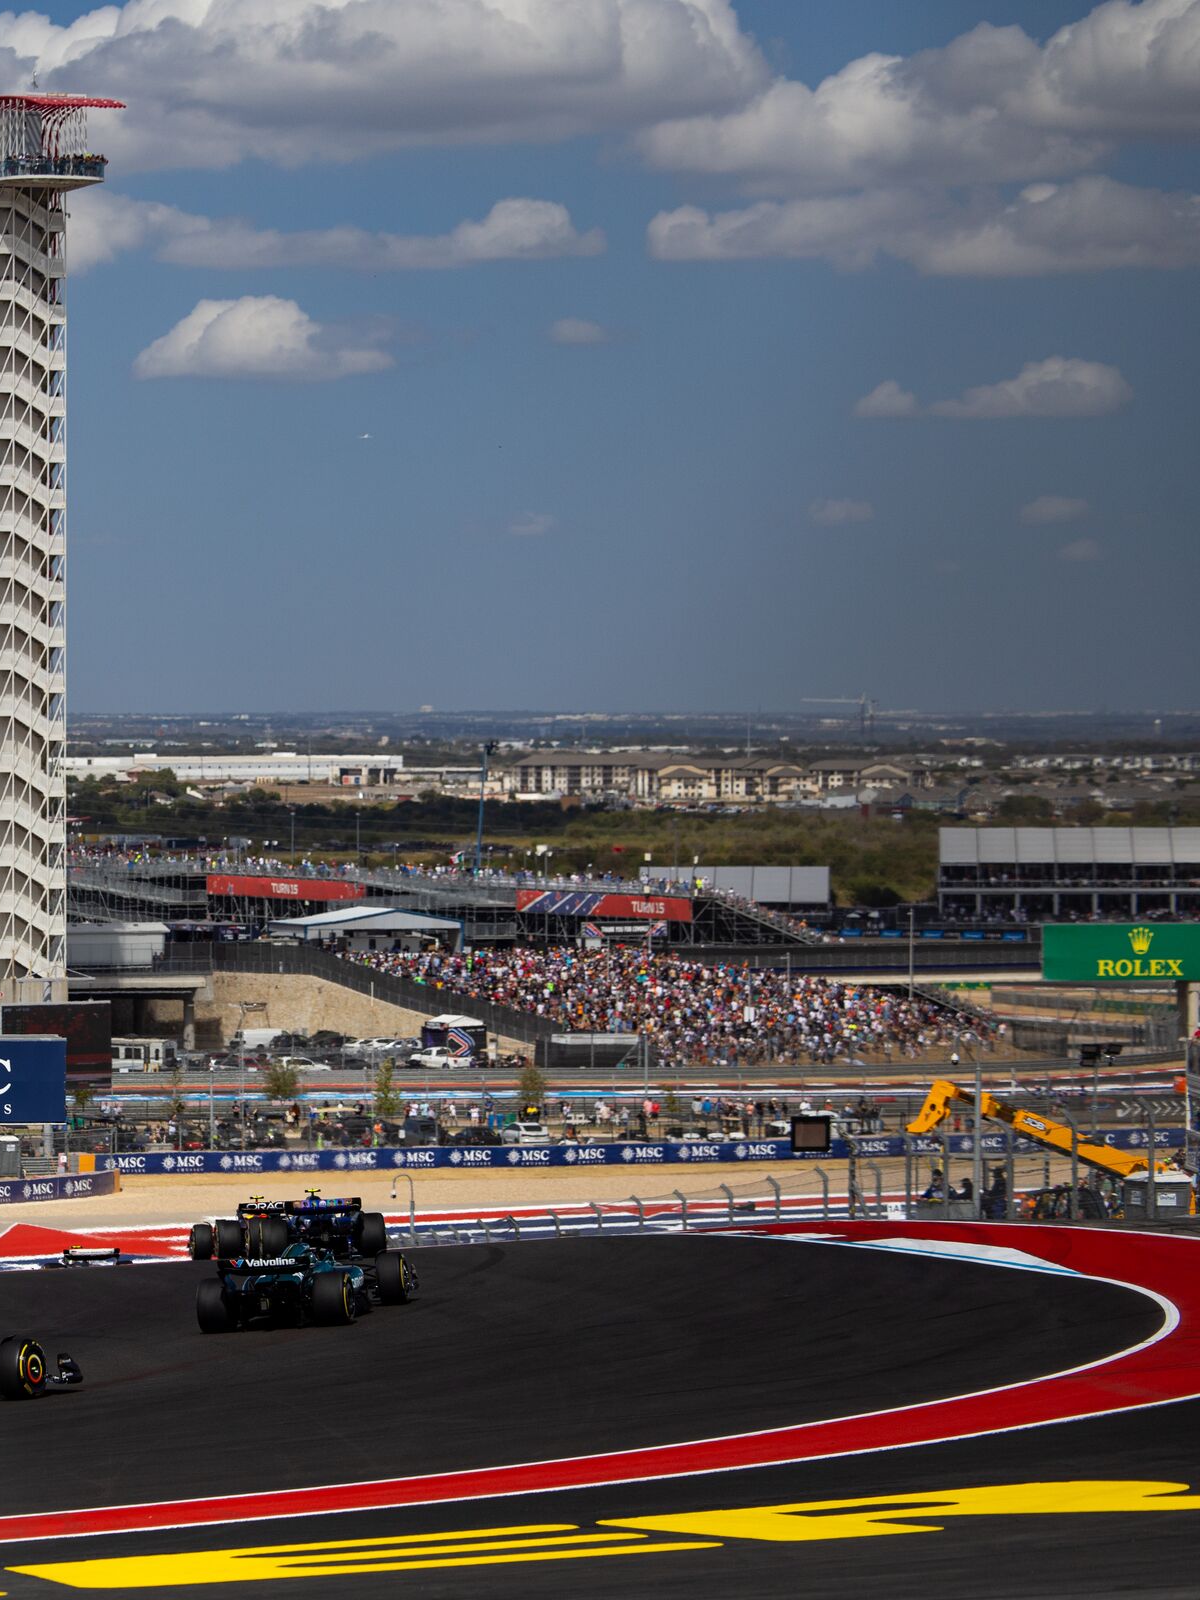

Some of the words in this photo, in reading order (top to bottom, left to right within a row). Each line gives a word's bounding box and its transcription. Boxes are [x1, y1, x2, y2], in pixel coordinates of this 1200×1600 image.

[632, 901, 655, 914] TURN
[655, 902, 665, 914] 15
[1097, 959, 1184, 977] ROLEX
[522, 1150, 549, 1160] MSC
[578, 1149, 605, 1159] MSC
[635, 1148, 662, 1158] MSC
[692, 1145, 720, 1156] MSC
[748, 1144, 776, 1155] MSC
[234, 1155, 262, 1166] MSC
[406, 1152, 434, 1162] MSC
[463, 1150, 491, 1161] MSC
[118, 1157, 145, 1168] MSC
[176, 1156, 204, 1167] MSC
[32, 1183, 53, 1194] MSC
[73, 1180, 92, 1191] MSC
[246, 1257, 296, 1268] Valvoline
